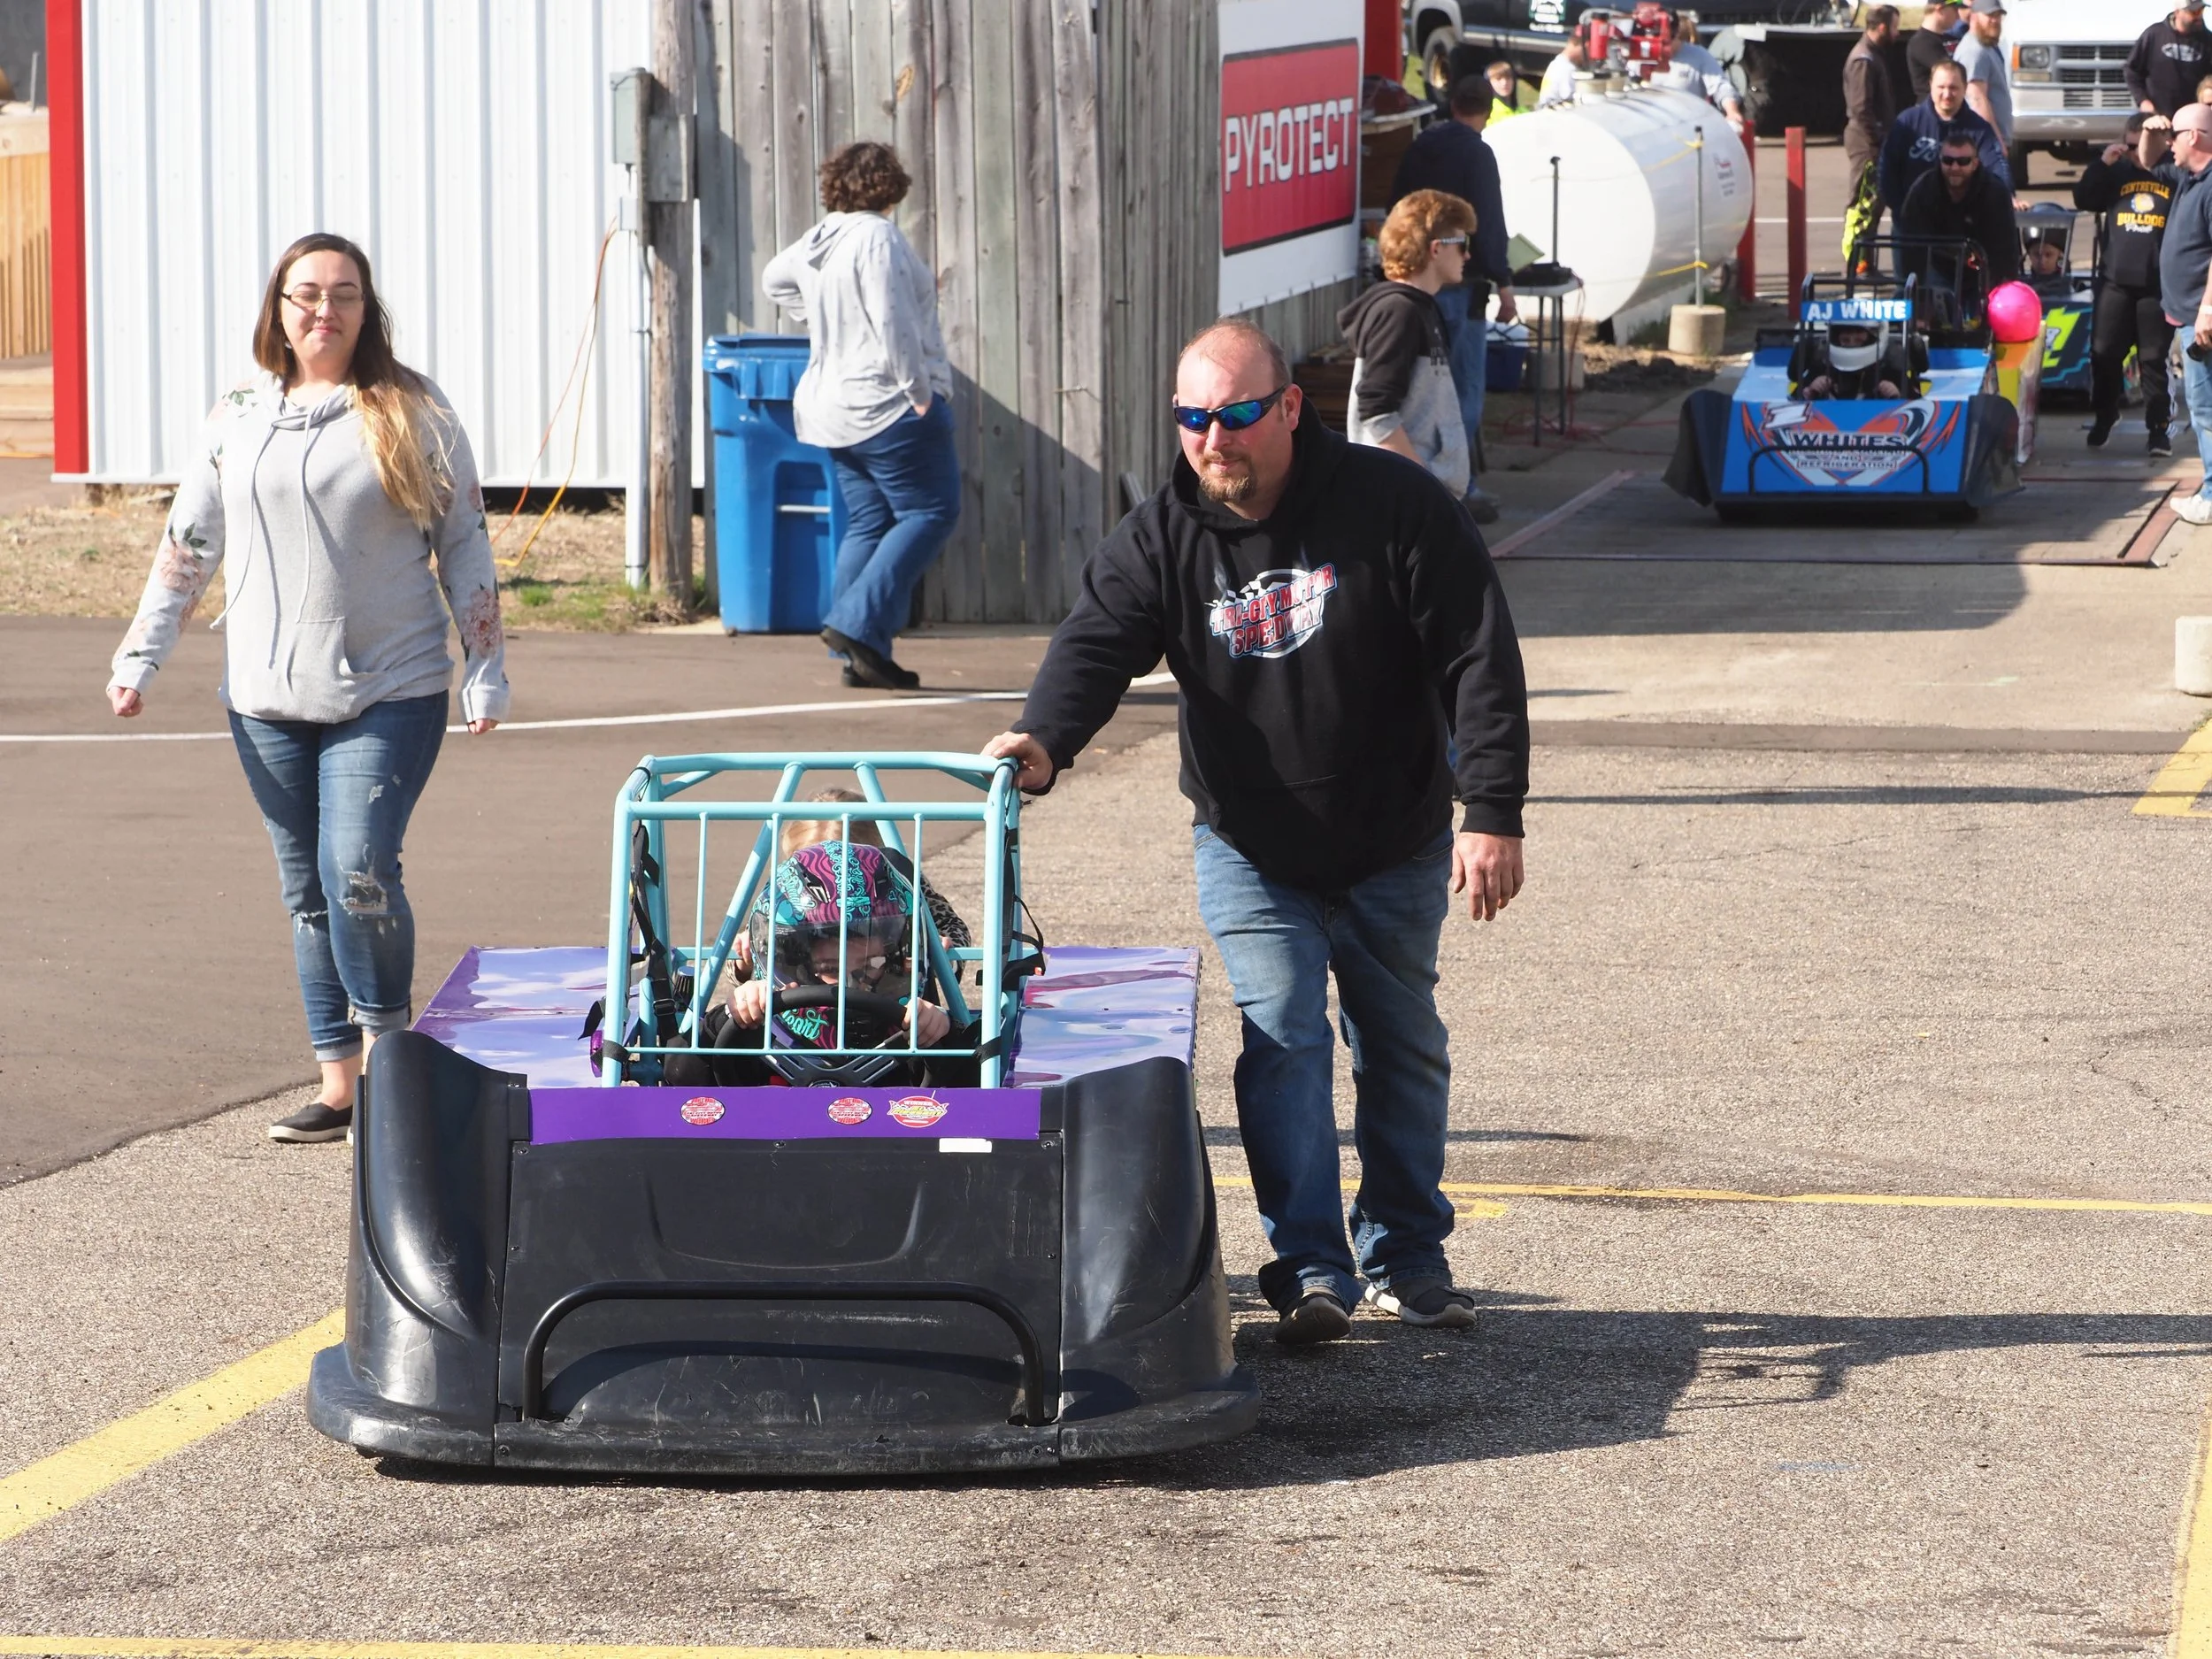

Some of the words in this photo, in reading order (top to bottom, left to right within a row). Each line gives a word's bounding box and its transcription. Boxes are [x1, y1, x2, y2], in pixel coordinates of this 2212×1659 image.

[1225, 96, 1355, 193] PYROTECT
[2116, 212, 2165, 227] BULLDOG
[1807, 303, 1833, 321] AJ
[1840, 301, 1907, 319] WHITE
[1793, 433, 1907, 449] WHITES
[1279, 564, 1336, 611] MOTOR
[1231, 595, 1323, 656] SPEDWAY
